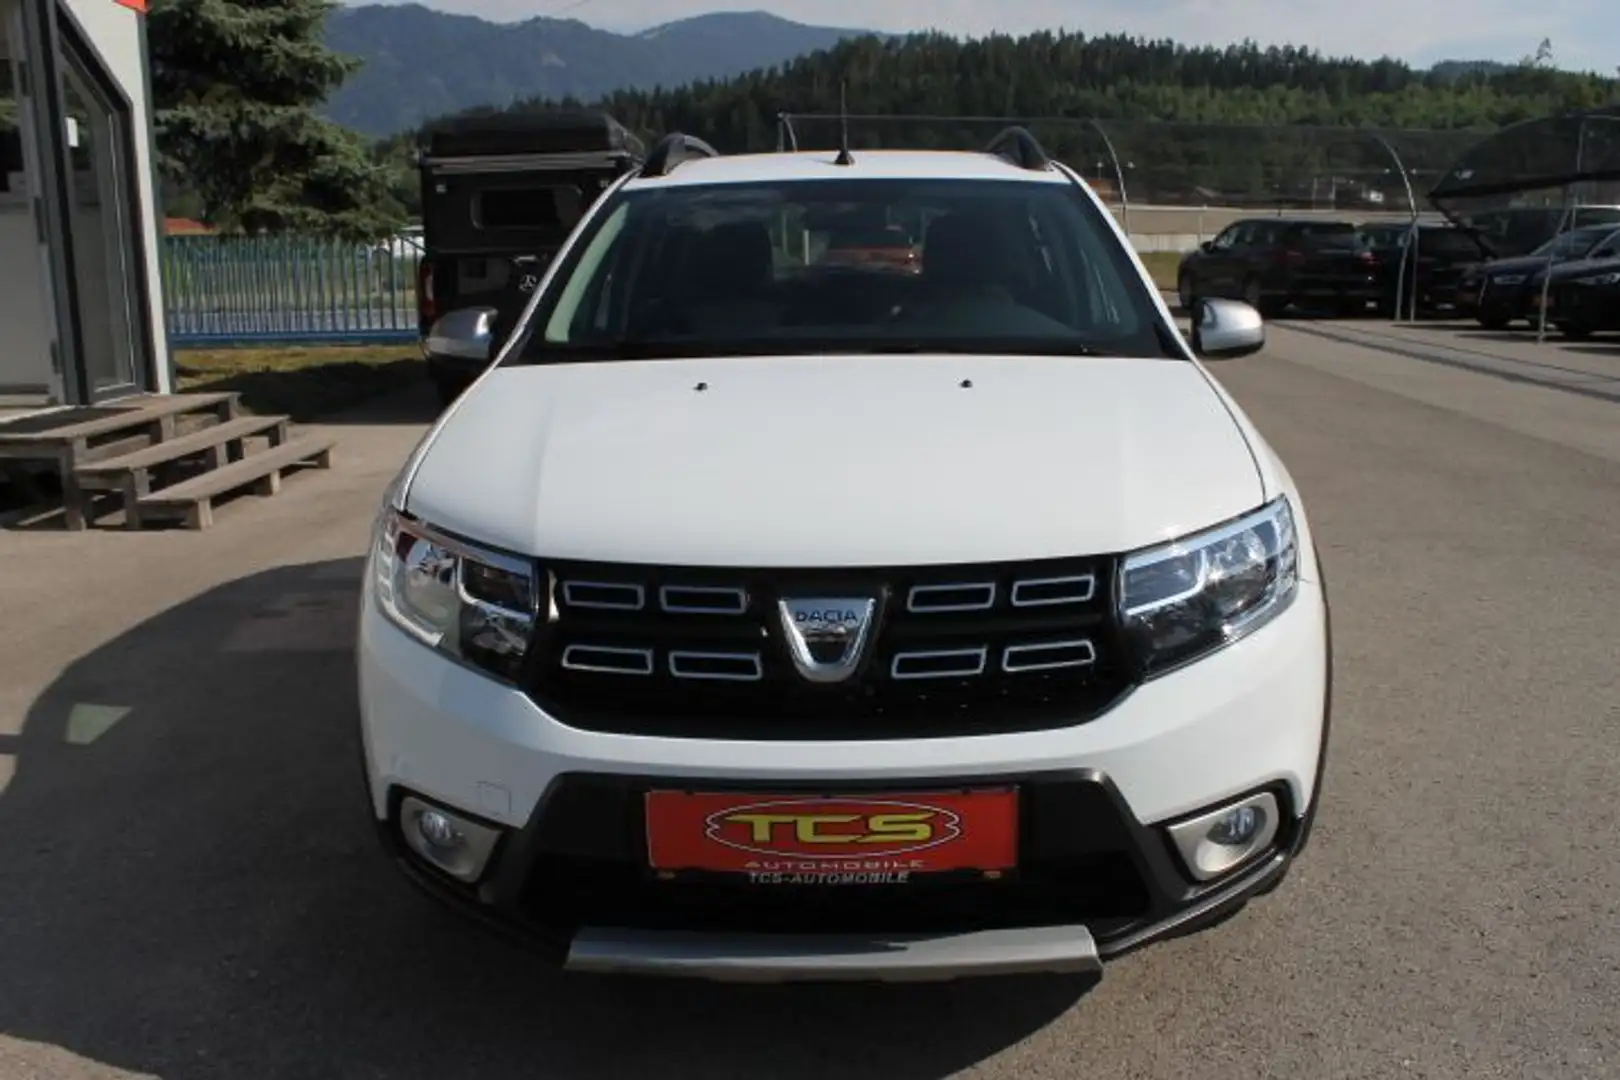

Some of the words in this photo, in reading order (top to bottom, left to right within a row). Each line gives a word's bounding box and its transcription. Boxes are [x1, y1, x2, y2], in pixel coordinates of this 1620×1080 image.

[796, 609, 858, 622] DACIA
[725, 812, 936, 843] TCS
[745, 860, 924, 870] AUTOMOBILE
[750, 871, 909, 884] TCS-AUTOMOBILE
